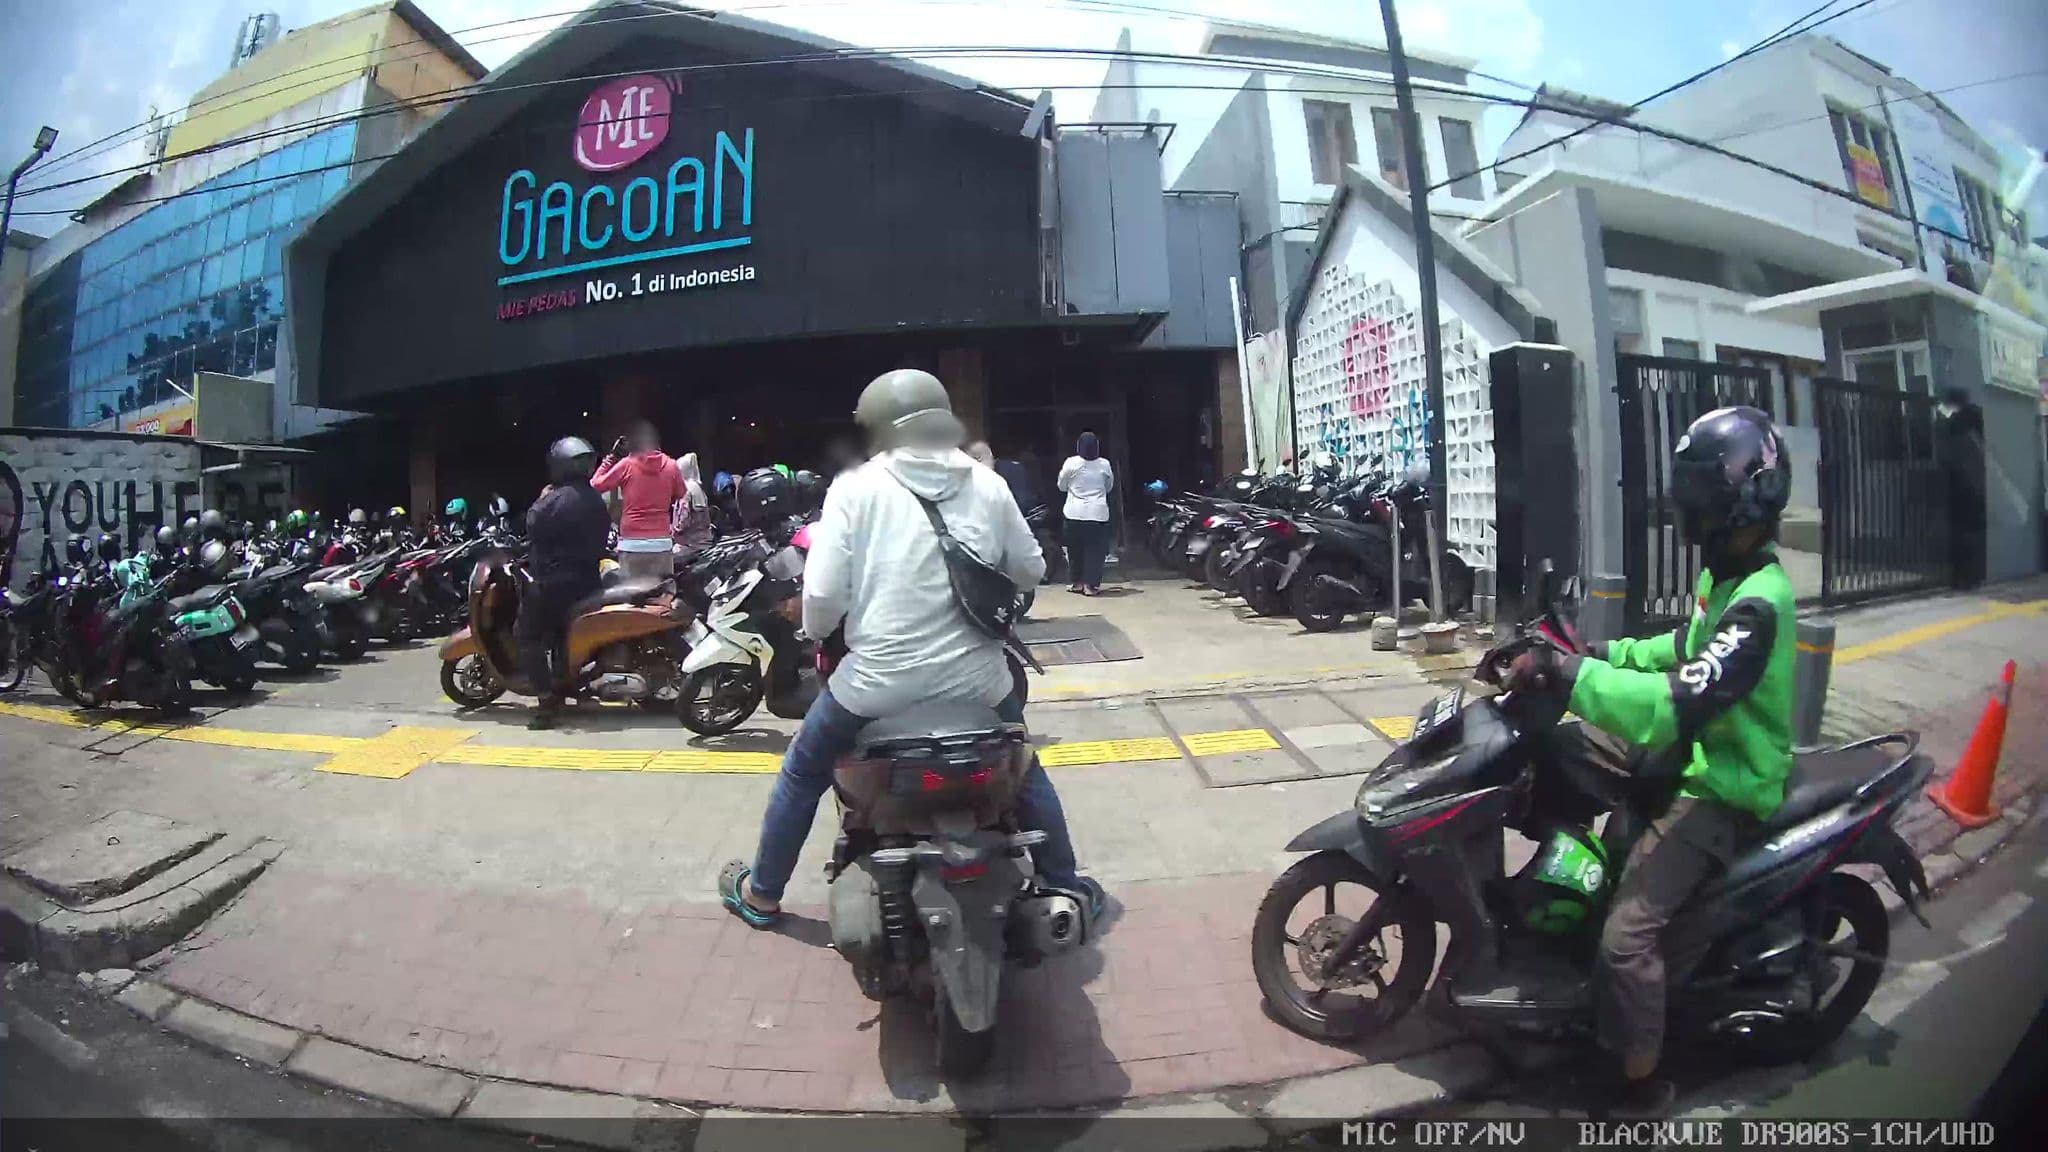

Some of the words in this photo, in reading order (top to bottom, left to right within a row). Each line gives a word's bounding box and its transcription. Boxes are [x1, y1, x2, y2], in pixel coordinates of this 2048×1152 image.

[499, 127, 754, 265] GACOAN
[497, 301, 525, 320] MIE
[528, 289, 576, 314] PEDAS
[585, 279, 623, 304] No.
[631, 272, 643, 296] 1
[649, 277, 665, 293] di
[669, 264, 756, 290] Indonesia
[32, 479, 121, 534] YOU
